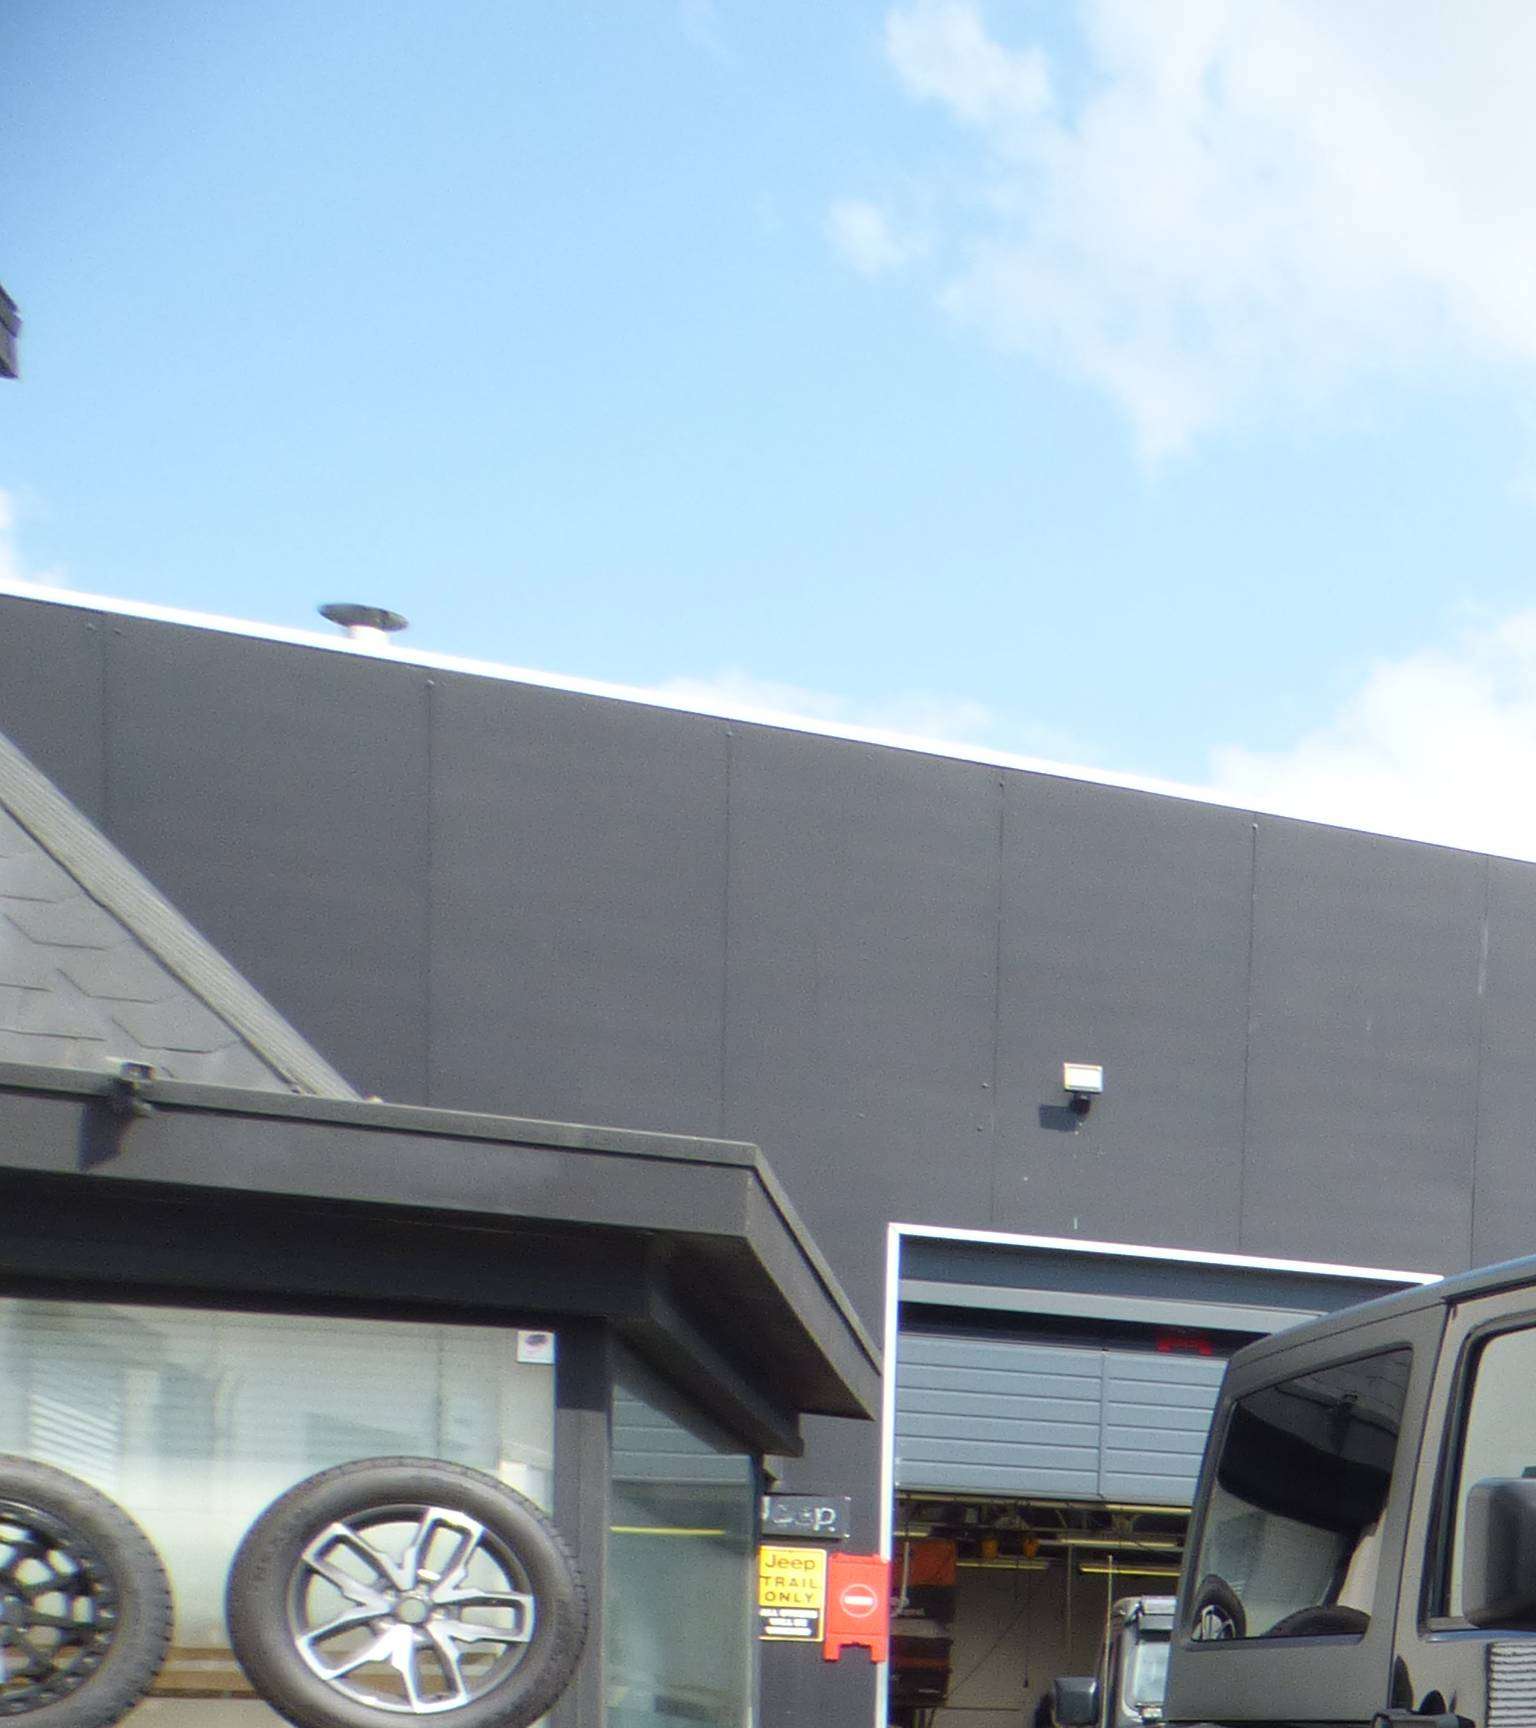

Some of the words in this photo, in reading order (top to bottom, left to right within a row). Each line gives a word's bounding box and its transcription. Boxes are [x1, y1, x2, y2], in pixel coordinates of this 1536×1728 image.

[764, 1554, 816, 1571] Jeep
[760, 1575, 818, 1588] TRAIL
[764, 1591, 815, 1602] ONLY
